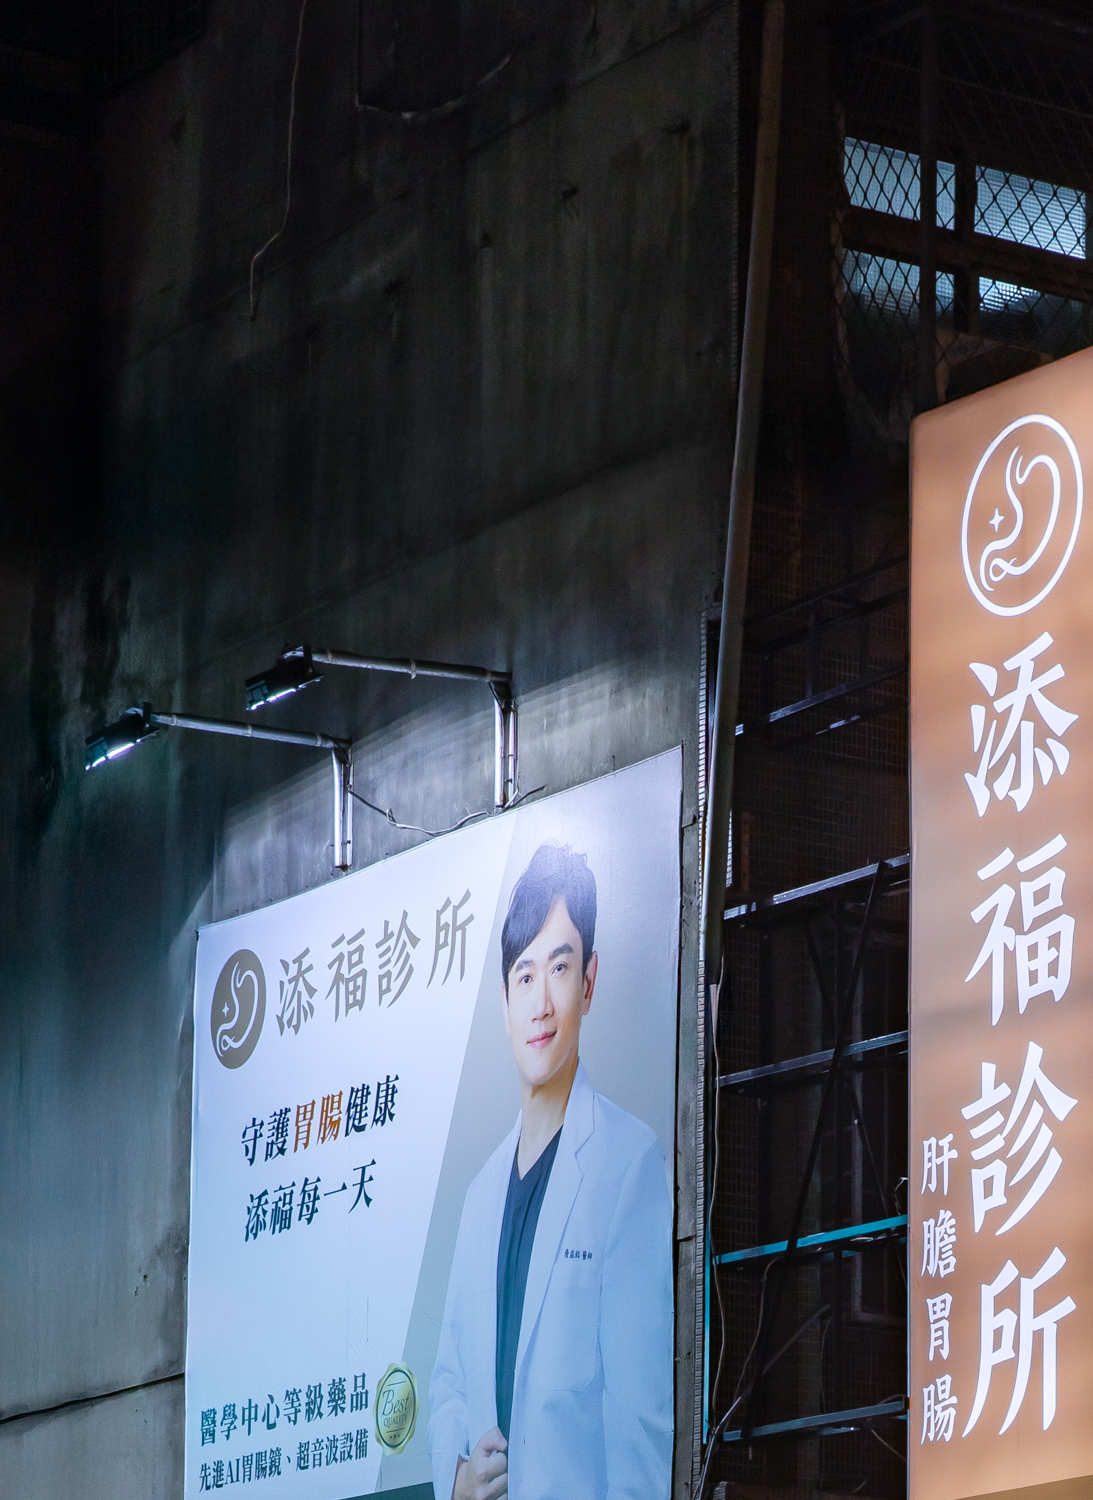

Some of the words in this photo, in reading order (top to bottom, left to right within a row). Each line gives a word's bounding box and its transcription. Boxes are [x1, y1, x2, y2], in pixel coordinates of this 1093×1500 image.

[274, 888, 475, 1037] 添福診所
[962, 631, 1079, 1437] 添福診所
[241, 1074, 399, 1166] 守護胃腸健康
[244, 1158, 376, 1242] 添福每一天
[919, 1133, 958, 1445] 肝膽胃腸
[201, 1372, 369, 1447] 醫學中心等級藥品
[381, 1389, 411, 1417] Best
[198, 1428, 369, 1493] 先進AI胃腸鏡、超音波設備
